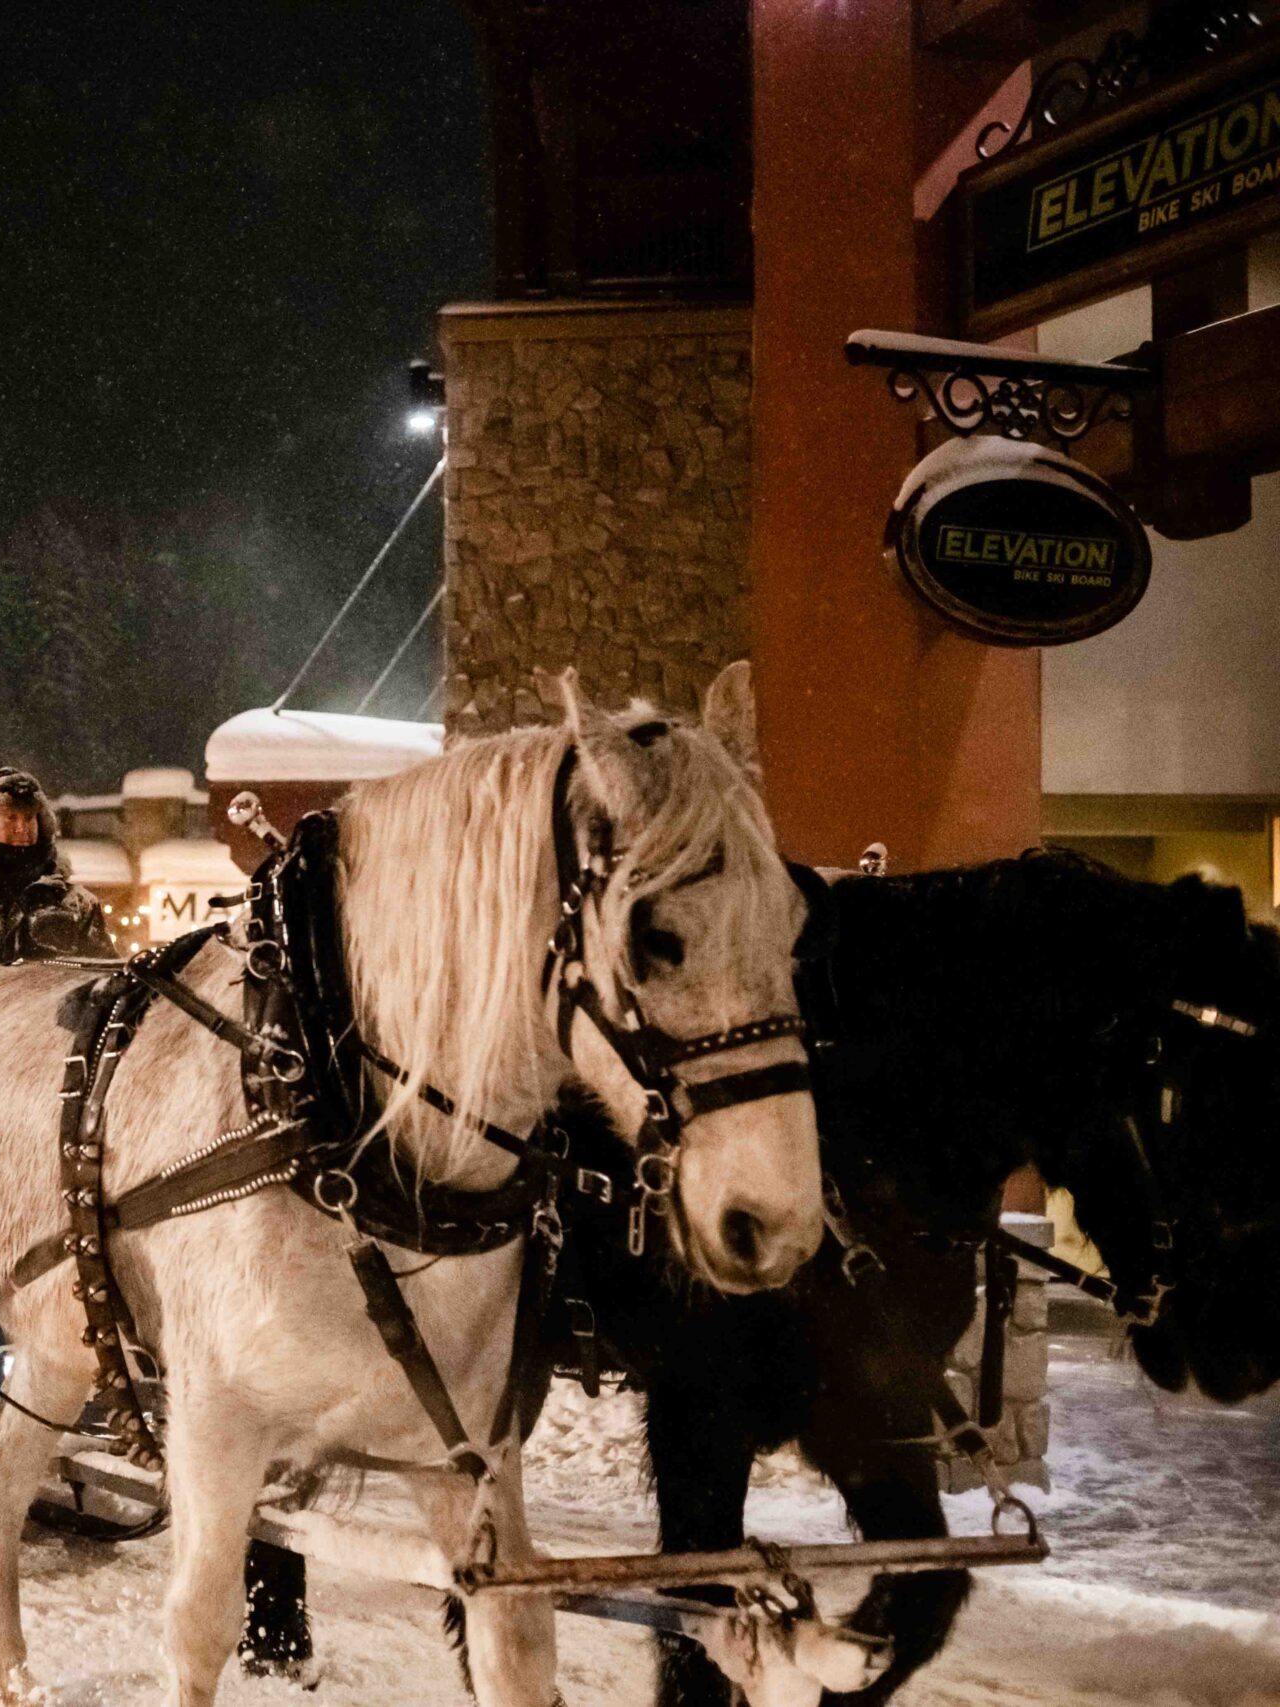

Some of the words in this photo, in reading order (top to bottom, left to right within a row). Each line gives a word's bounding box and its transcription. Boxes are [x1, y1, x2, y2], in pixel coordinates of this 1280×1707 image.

[1138, 198, 1181, 233] BIKE
[1190, 181, 1222, 212] SKI
[945, 529, 1109, 570] ELEVATION
[1013, 569, 1040, 582] BIKE
[1046, 572, 1065, 584] SKI
[1071, 574, 1112, 588] BOARD
